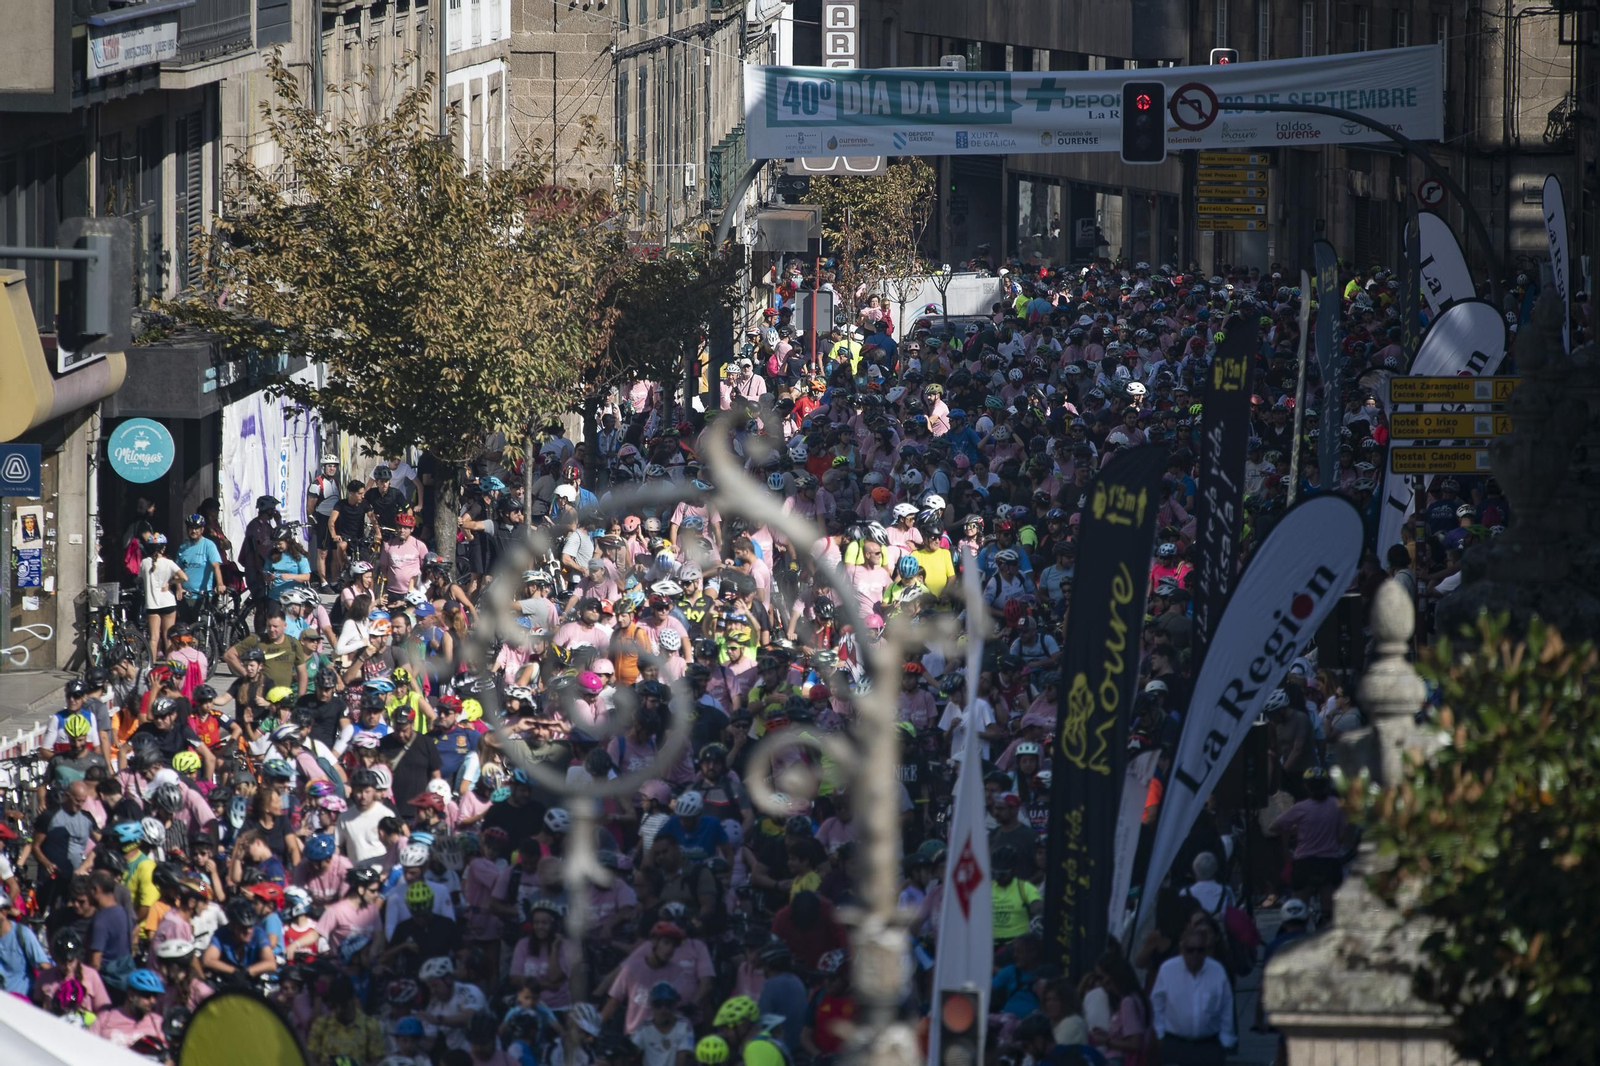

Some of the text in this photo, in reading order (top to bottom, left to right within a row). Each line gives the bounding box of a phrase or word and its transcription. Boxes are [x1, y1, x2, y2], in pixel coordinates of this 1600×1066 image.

[843, 74, 892, 115] DÍA
[900, 80, 940, 115] DA
[948, 79, 1005, 114] BICI
[1254, 94, 1279, 114] DE
[1288, 86, 1417, 112] SEPTIEMBRE
[1088, 110, 1105, 119] La
[1276, 121, 1313, 131] toldos
[1276, 130, 1321, 139] ourense
[986, 139, 1017, 147] GALICIA
[1057, 137, 1099, 145] OURENSE
[1167, 135, 1202, 144] telemiño
[1420, 252, 1443, 297] La
[1393, 382, 1470, 392] hotel Zarampallo
[1393, 391, 1425, 399] (acceso
[1393, 417, 1458, 426] hotel O Irixo
[1393, 427, 1425, 435] (acceso
[114, 447, 164, 467] Milongas
[1395, 451, 1472, 461] hostal Cándido
[1395, 461, 1426, 469] (acceso
[1089, 562, 1134, 776] Moure
[1174, 730, 1230, 796] La
